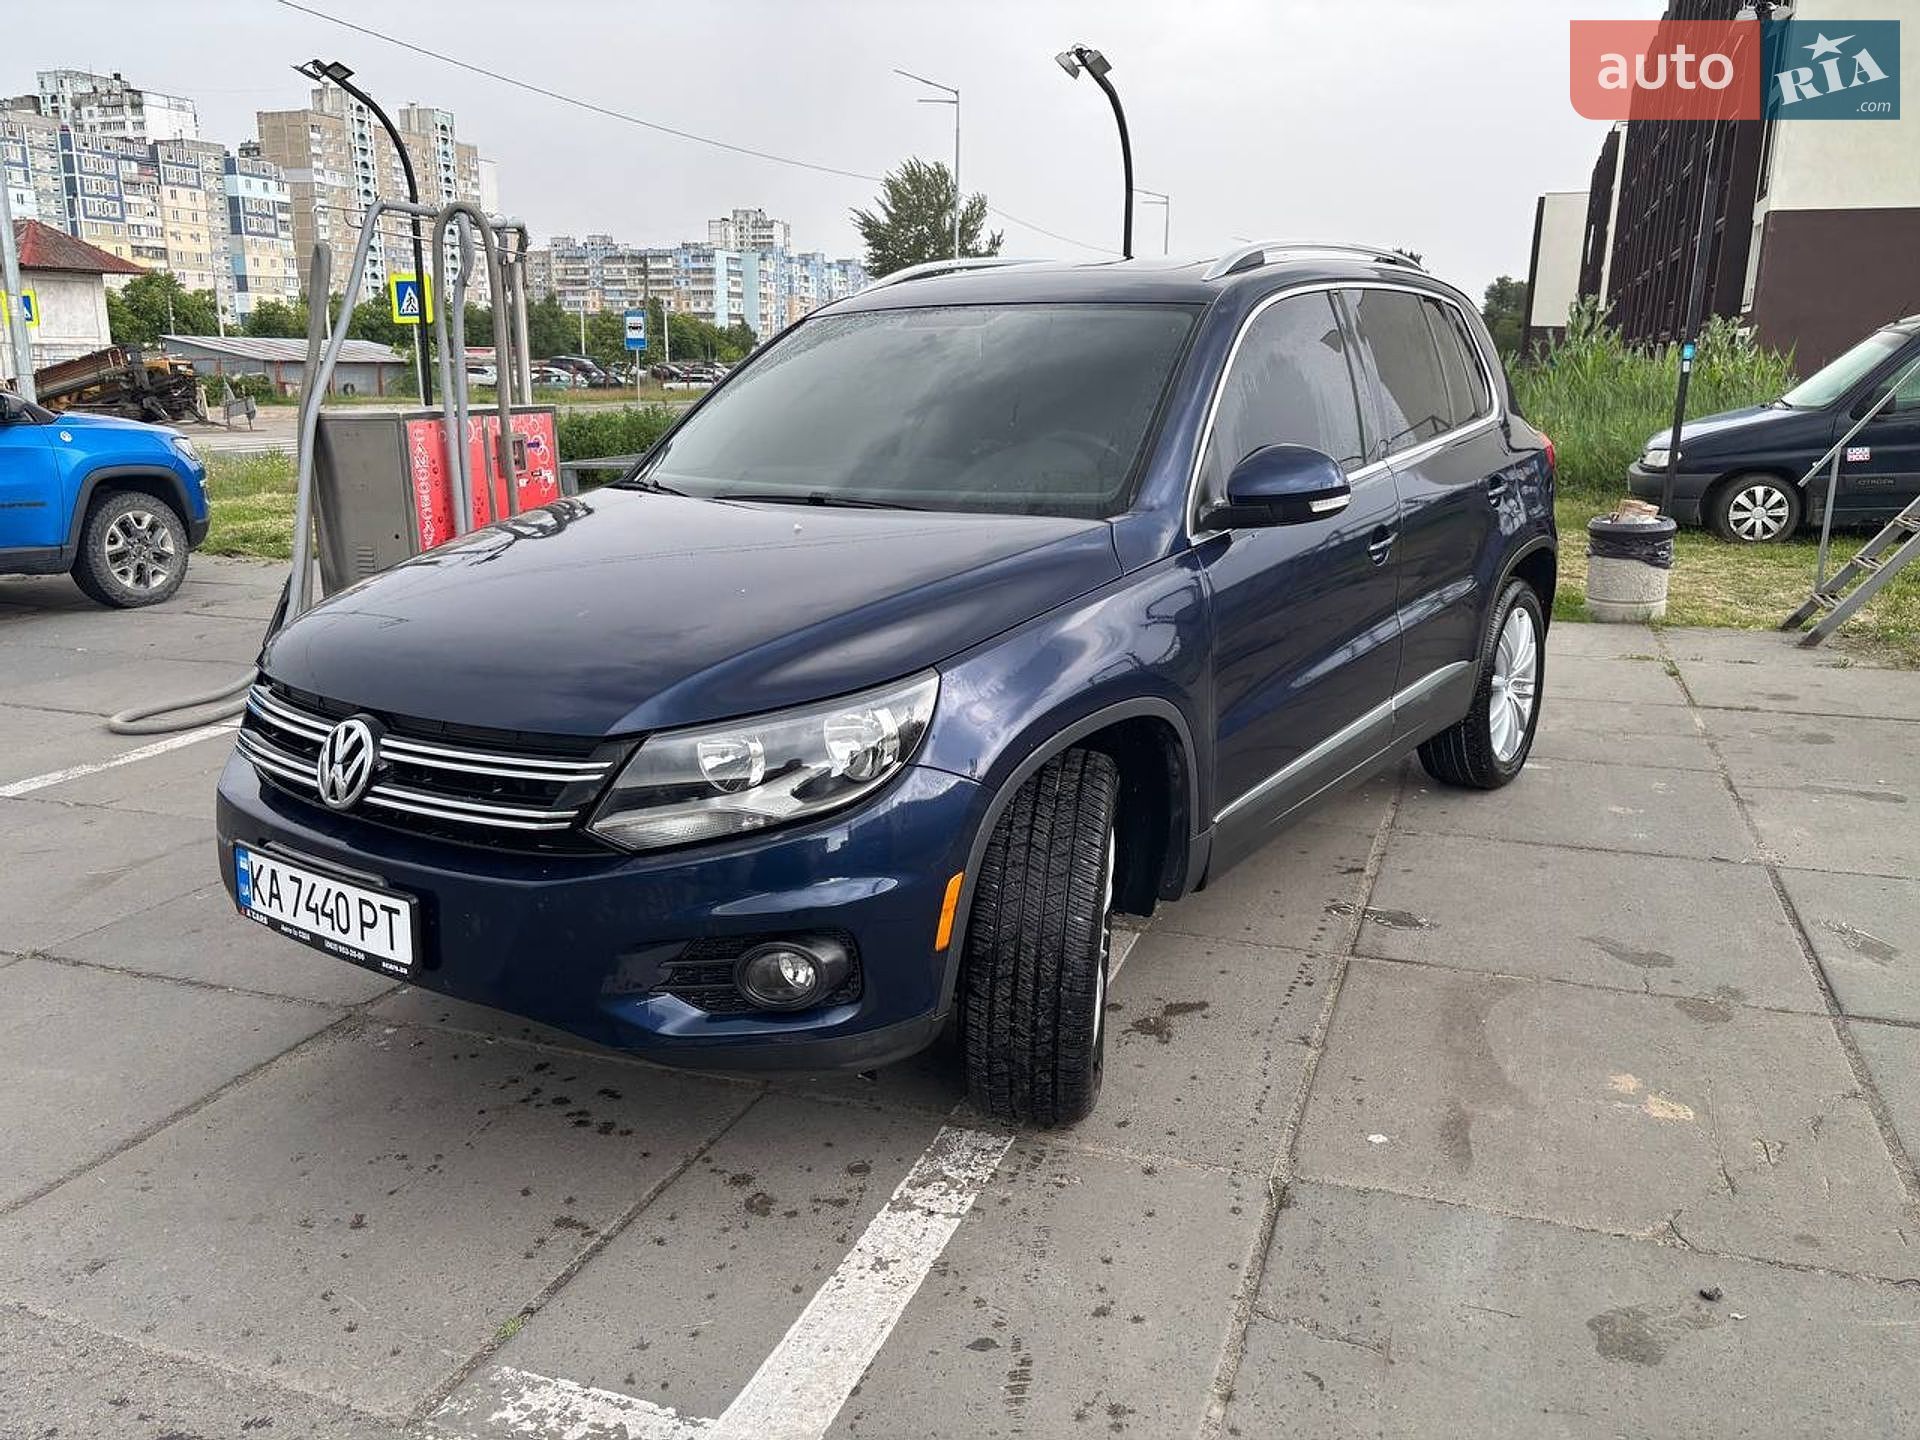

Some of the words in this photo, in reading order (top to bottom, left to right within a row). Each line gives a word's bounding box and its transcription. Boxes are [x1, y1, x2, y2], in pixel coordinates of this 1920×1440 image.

[250, 860, 283, 914] KA
[288, 874, 351, 935] 7440
[358, 897, 400, 951] PT
